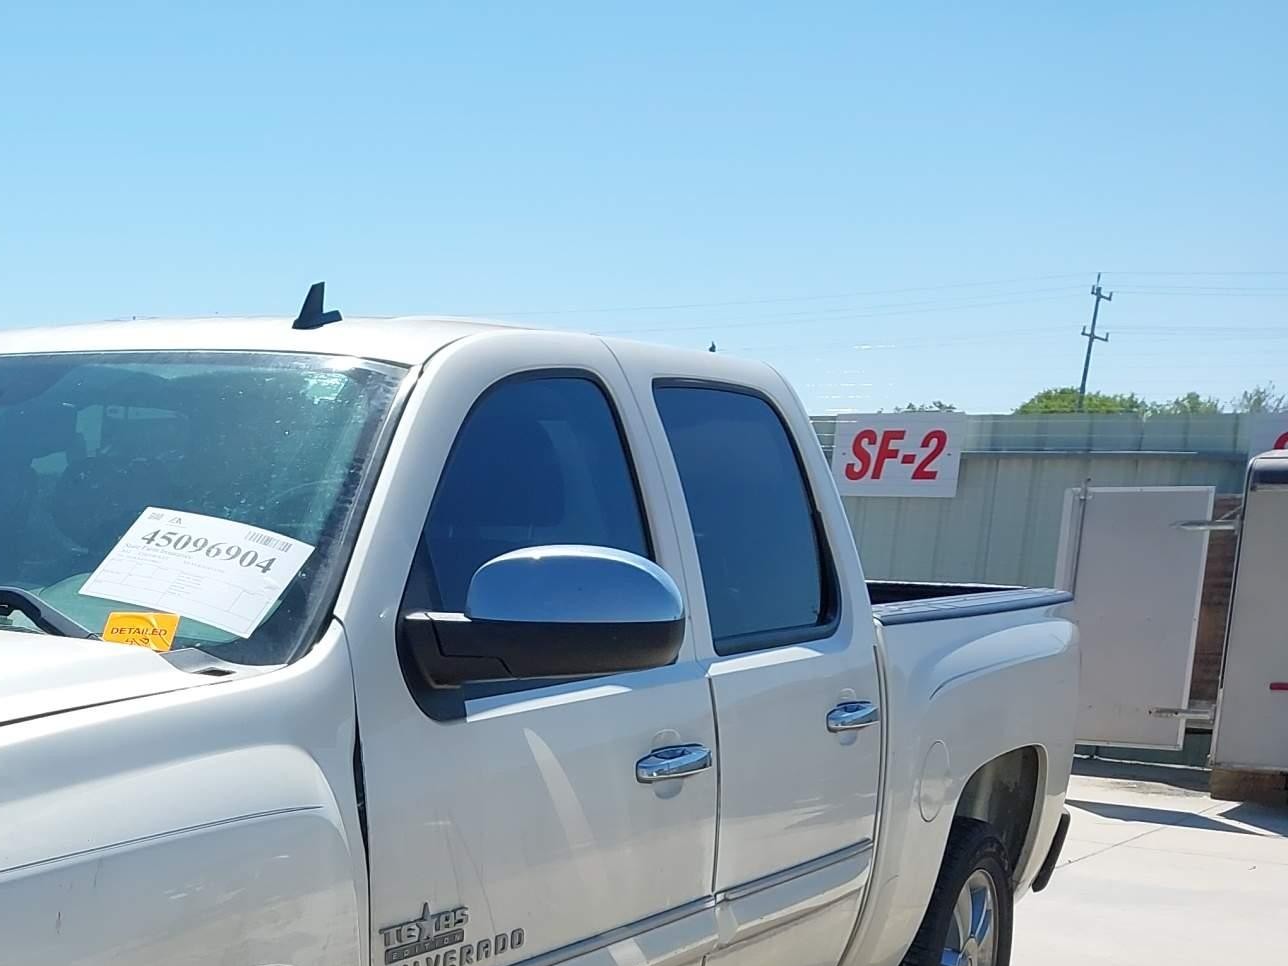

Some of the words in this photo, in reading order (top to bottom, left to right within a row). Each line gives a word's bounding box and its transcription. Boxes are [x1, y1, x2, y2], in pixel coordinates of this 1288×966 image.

[845, 429, 948, 481] SF-2
[141, 529, 277, 574] 45096904
[111, 627, 168, 636] DETAILED
